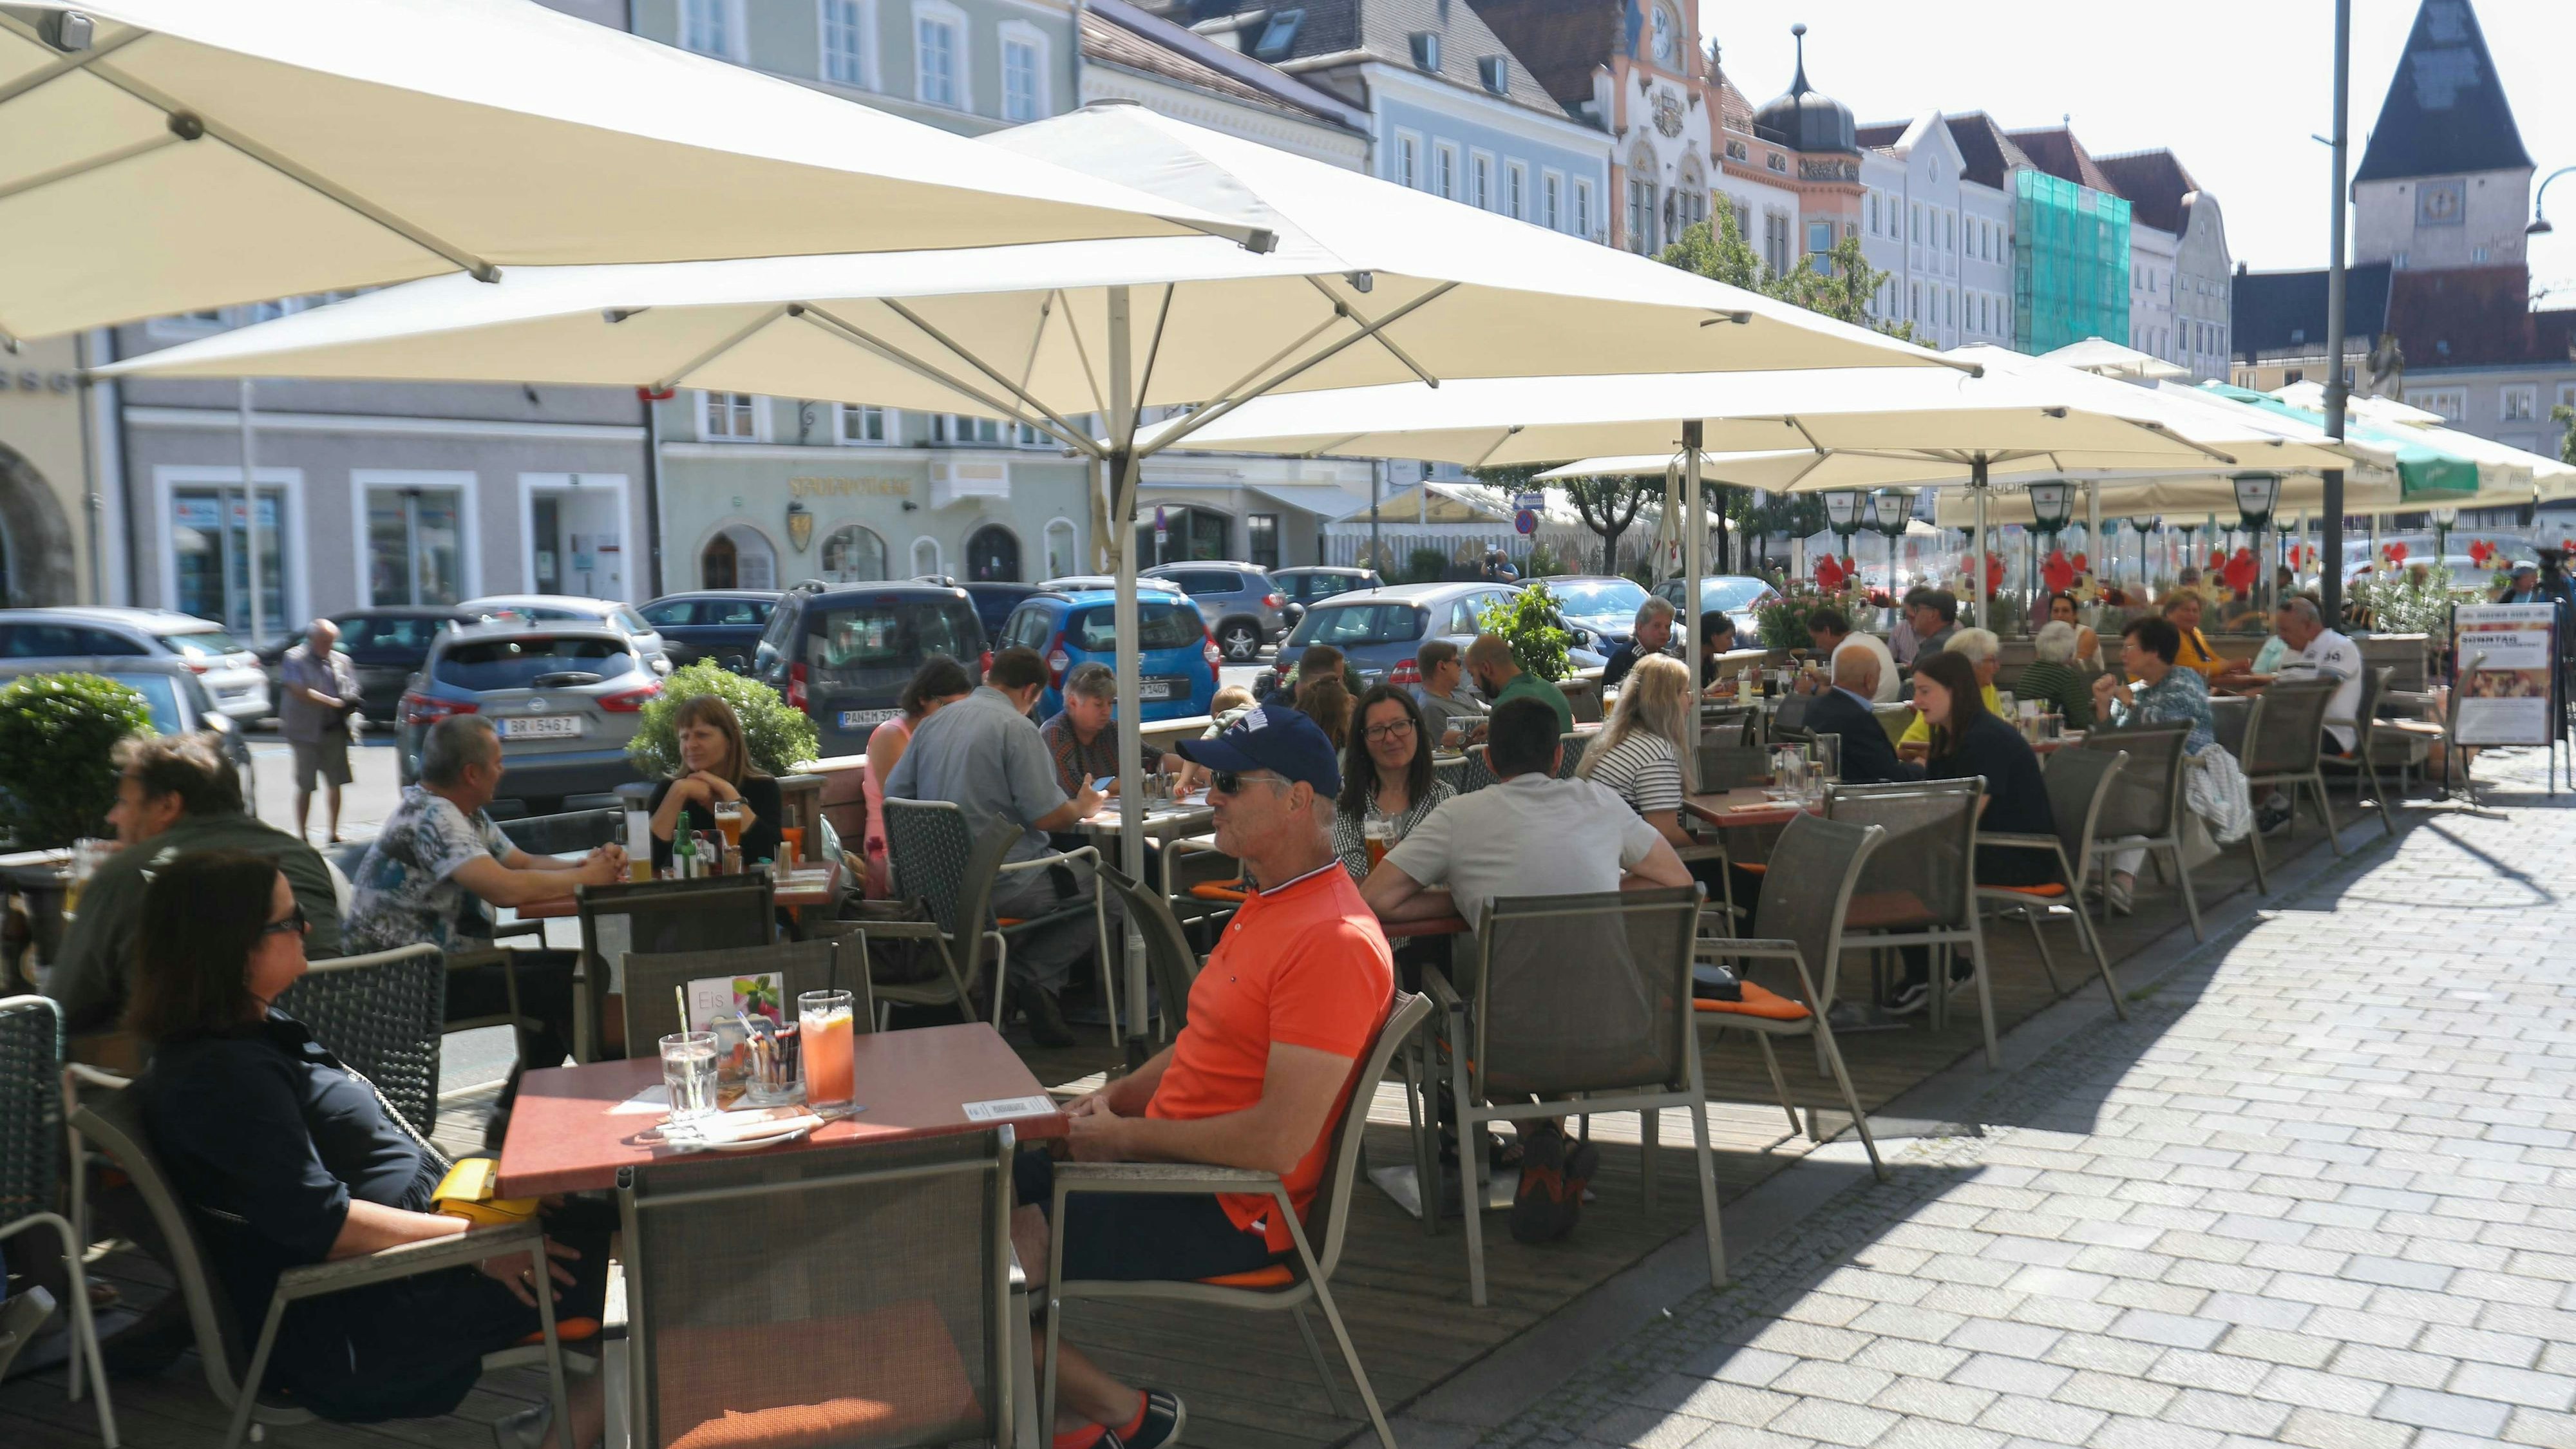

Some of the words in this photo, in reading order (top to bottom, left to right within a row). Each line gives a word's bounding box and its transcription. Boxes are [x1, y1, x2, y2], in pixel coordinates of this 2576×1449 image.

[1147, 684, 1167, 694] 1407
[844, 712, 864, 723] PAN
[511, 719, 527, 732] BR
[698, 991, 724, 1009] Eis
